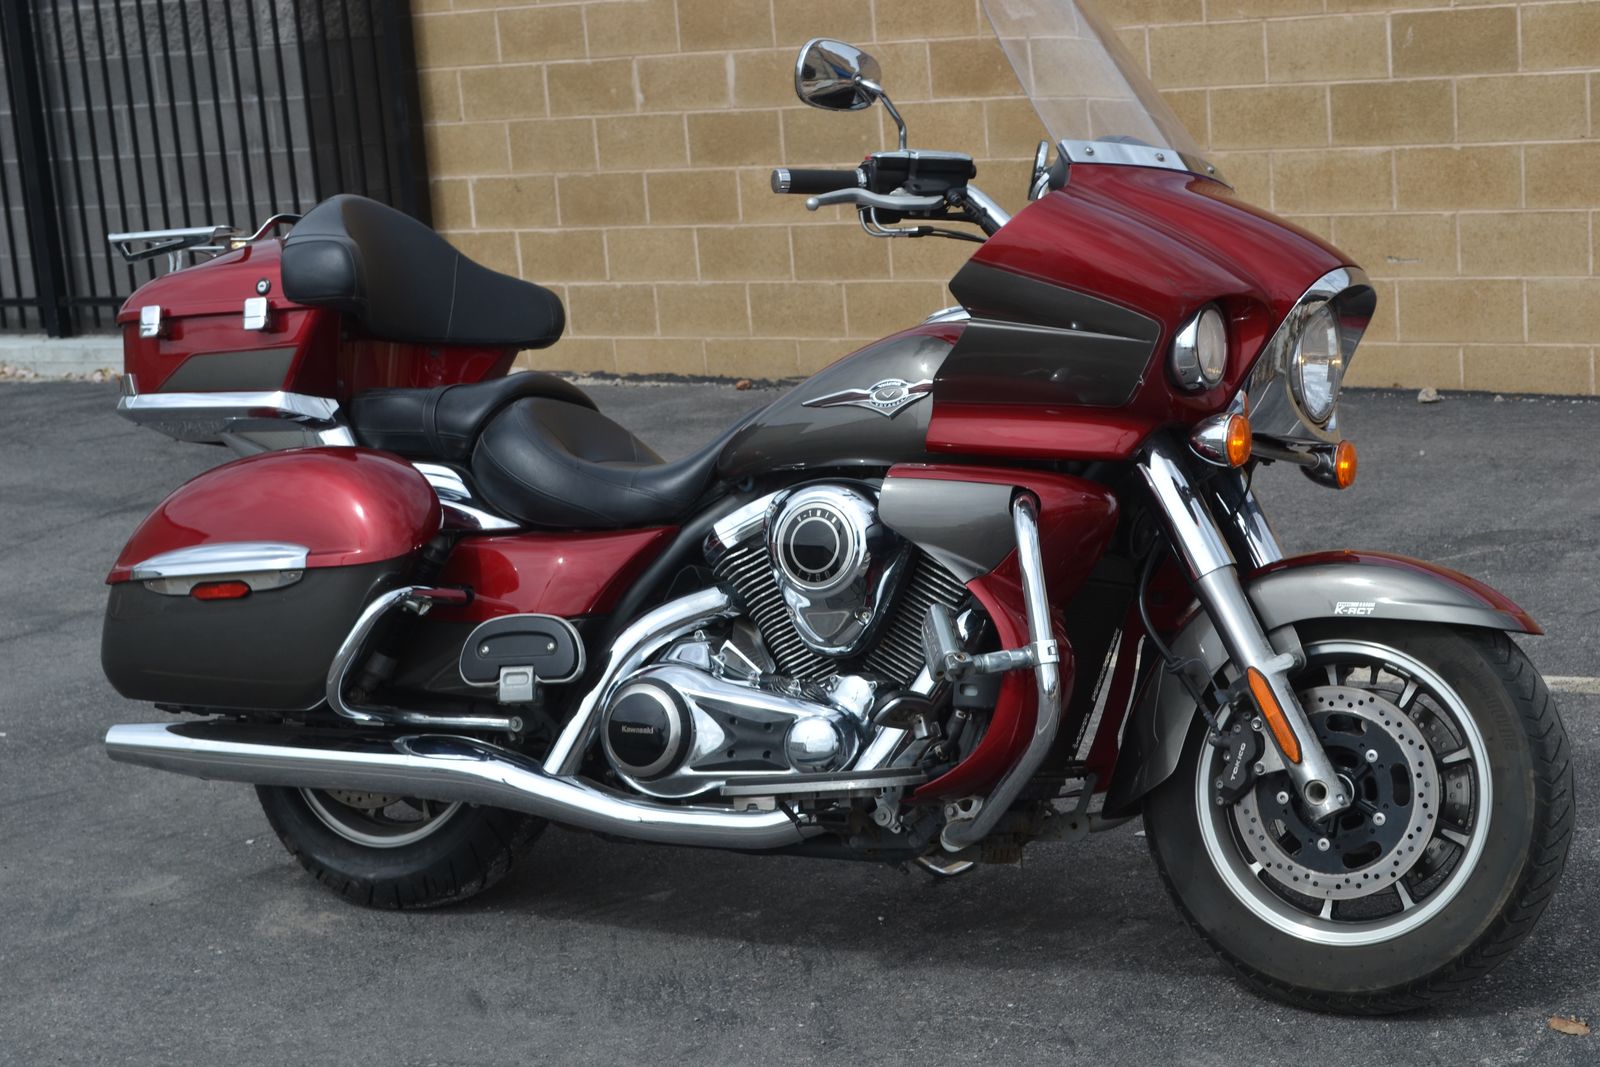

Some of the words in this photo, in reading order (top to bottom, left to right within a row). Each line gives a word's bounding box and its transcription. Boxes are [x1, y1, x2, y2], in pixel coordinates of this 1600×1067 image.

[1334, 601, 1375, 615] K-ACT
[621, 725, 653, 734] Kawasaki
[1230, 742, 1246, 781] TOKICO
